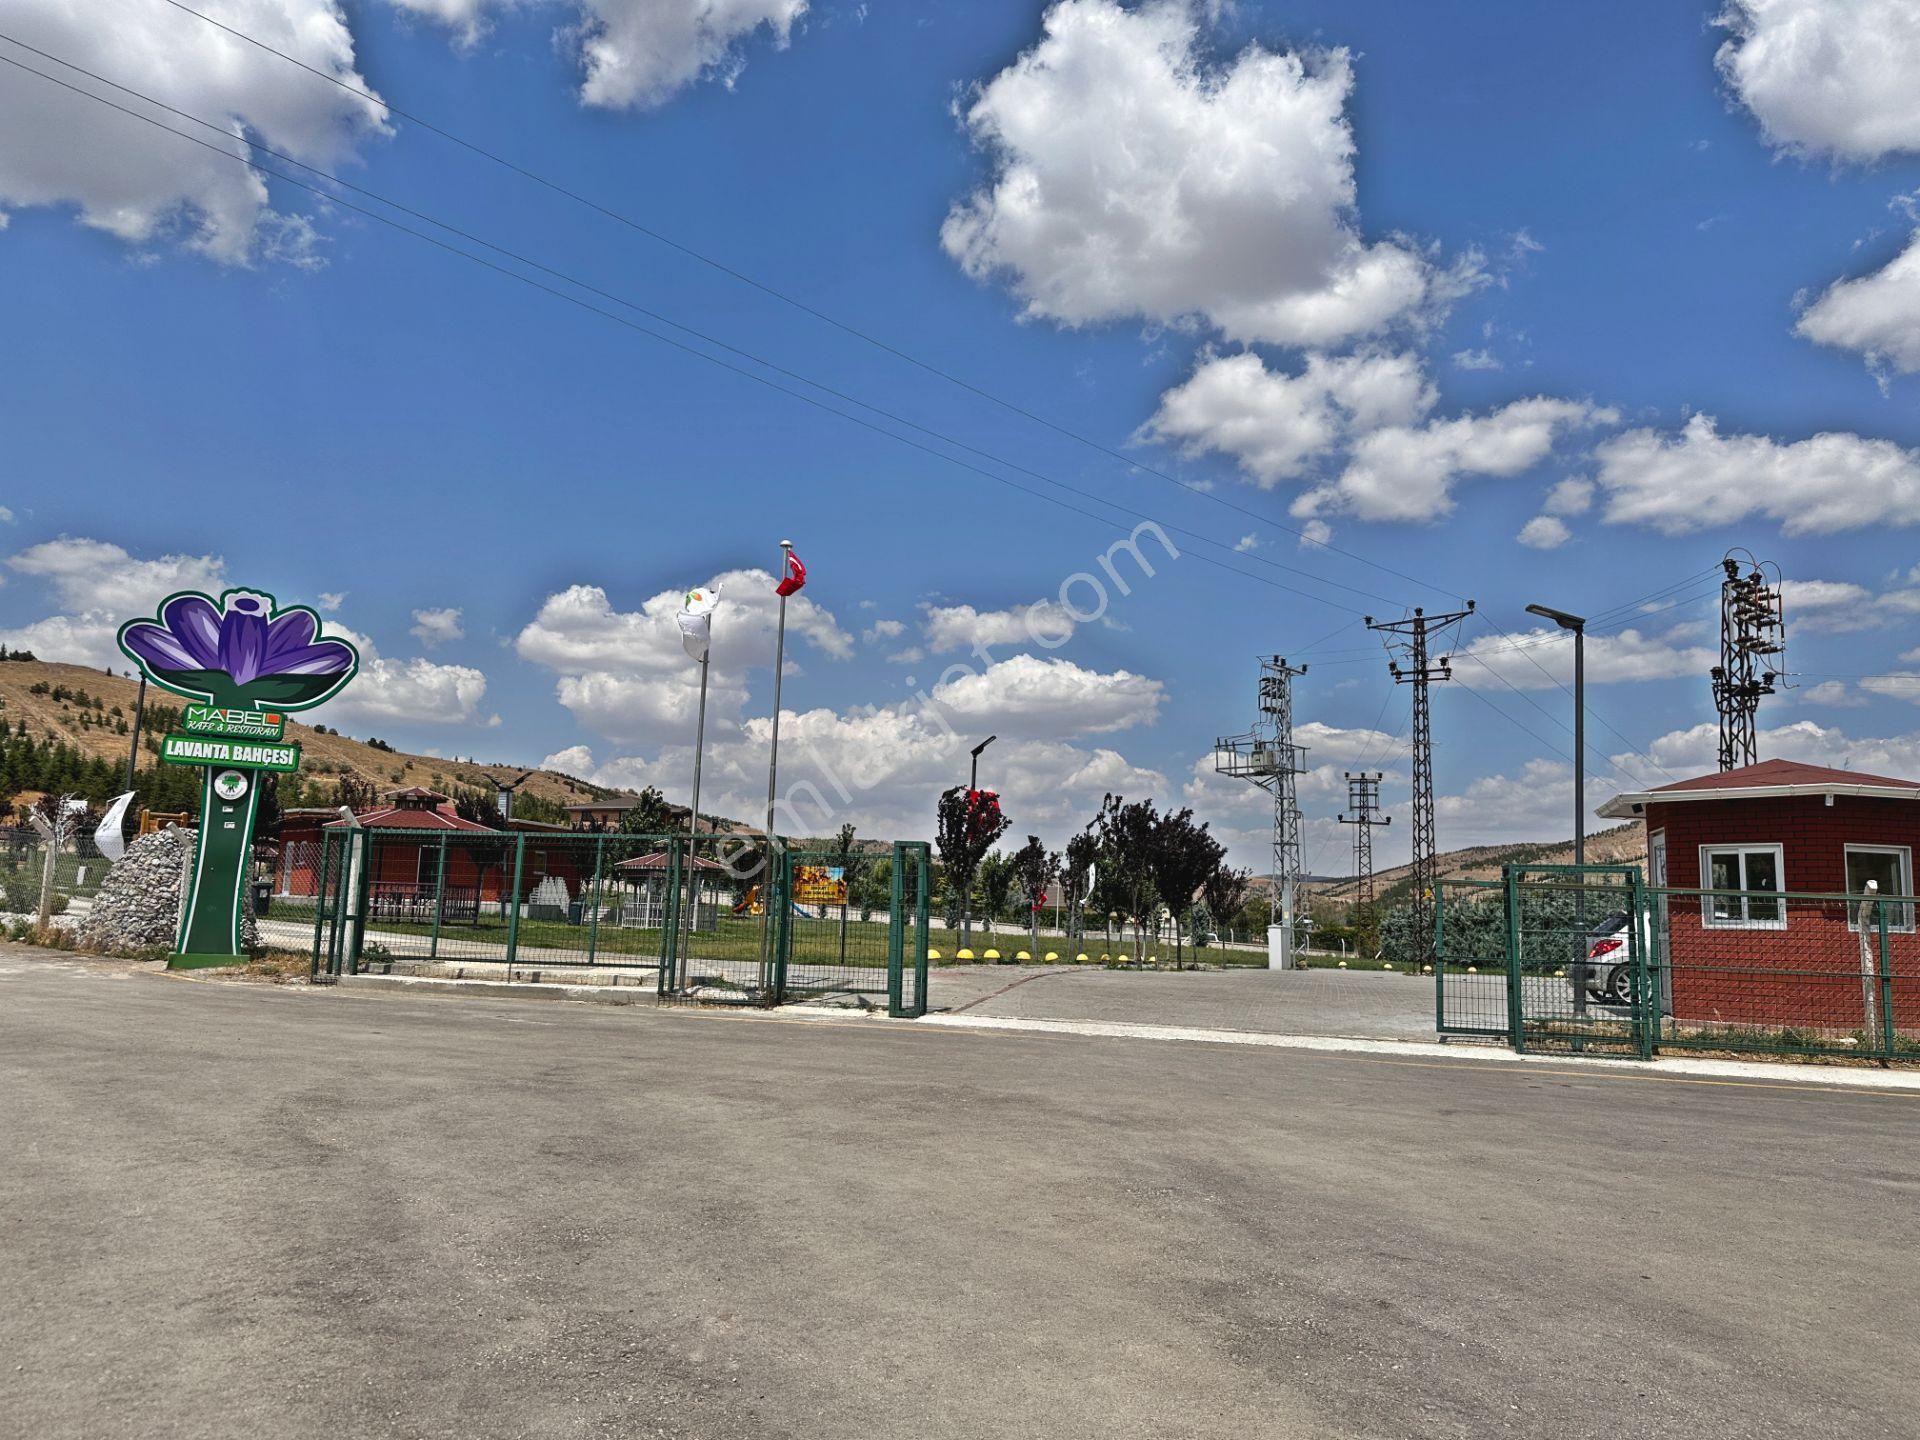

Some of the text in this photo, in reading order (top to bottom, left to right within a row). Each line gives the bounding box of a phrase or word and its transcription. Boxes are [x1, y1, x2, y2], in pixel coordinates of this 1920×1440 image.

[187, 707, 280, 727] MABEL
[187, 720, 279, 736] KAFE & RESTORAN
[166, 740, 294, 765] LAVANTA BAHÇESİ
